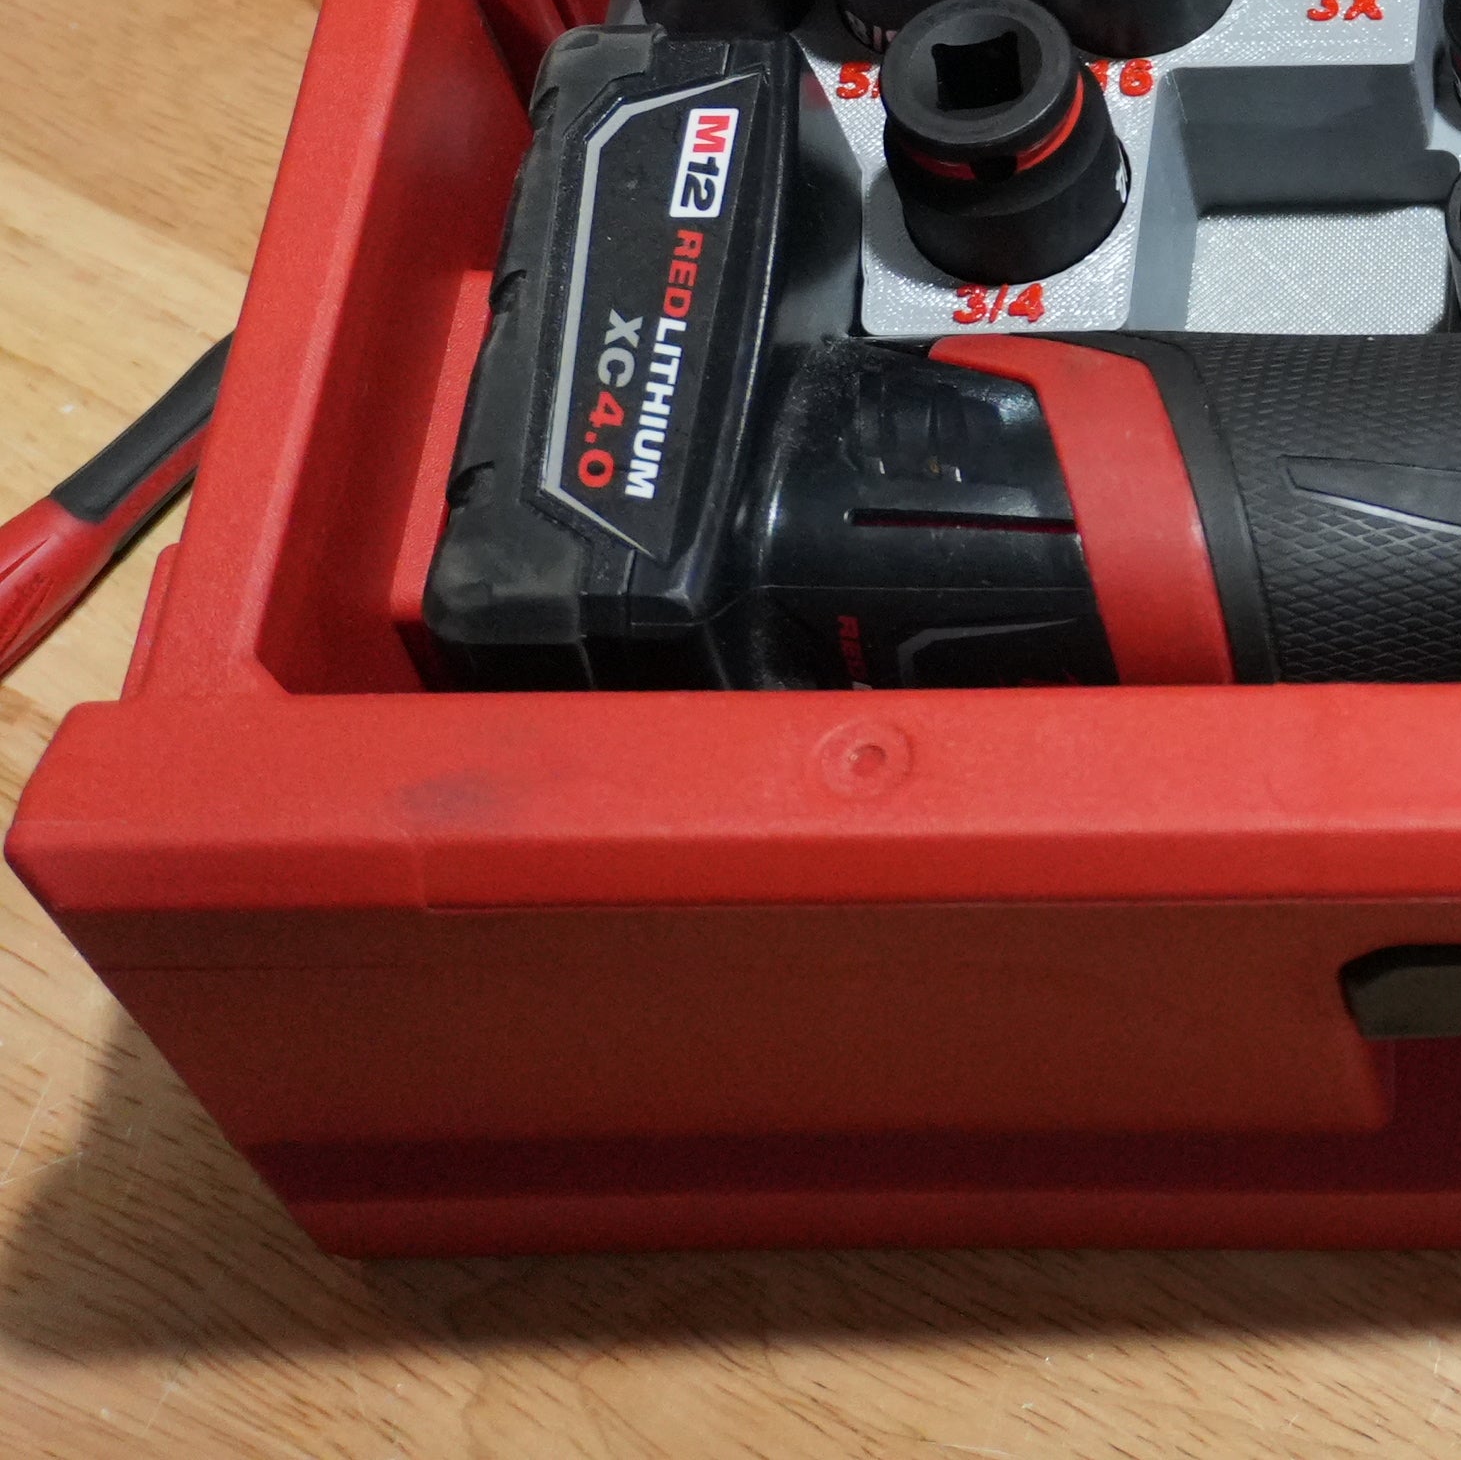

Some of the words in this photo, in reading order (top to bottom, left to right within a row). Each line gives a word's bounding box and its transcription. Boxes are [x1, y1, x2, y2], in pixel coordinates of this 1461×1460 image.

[679, 114, 731, 213] M12
[953, 283, 1045, 324] 3/4
[624, 228, 705, 500] REDLITHIUM
